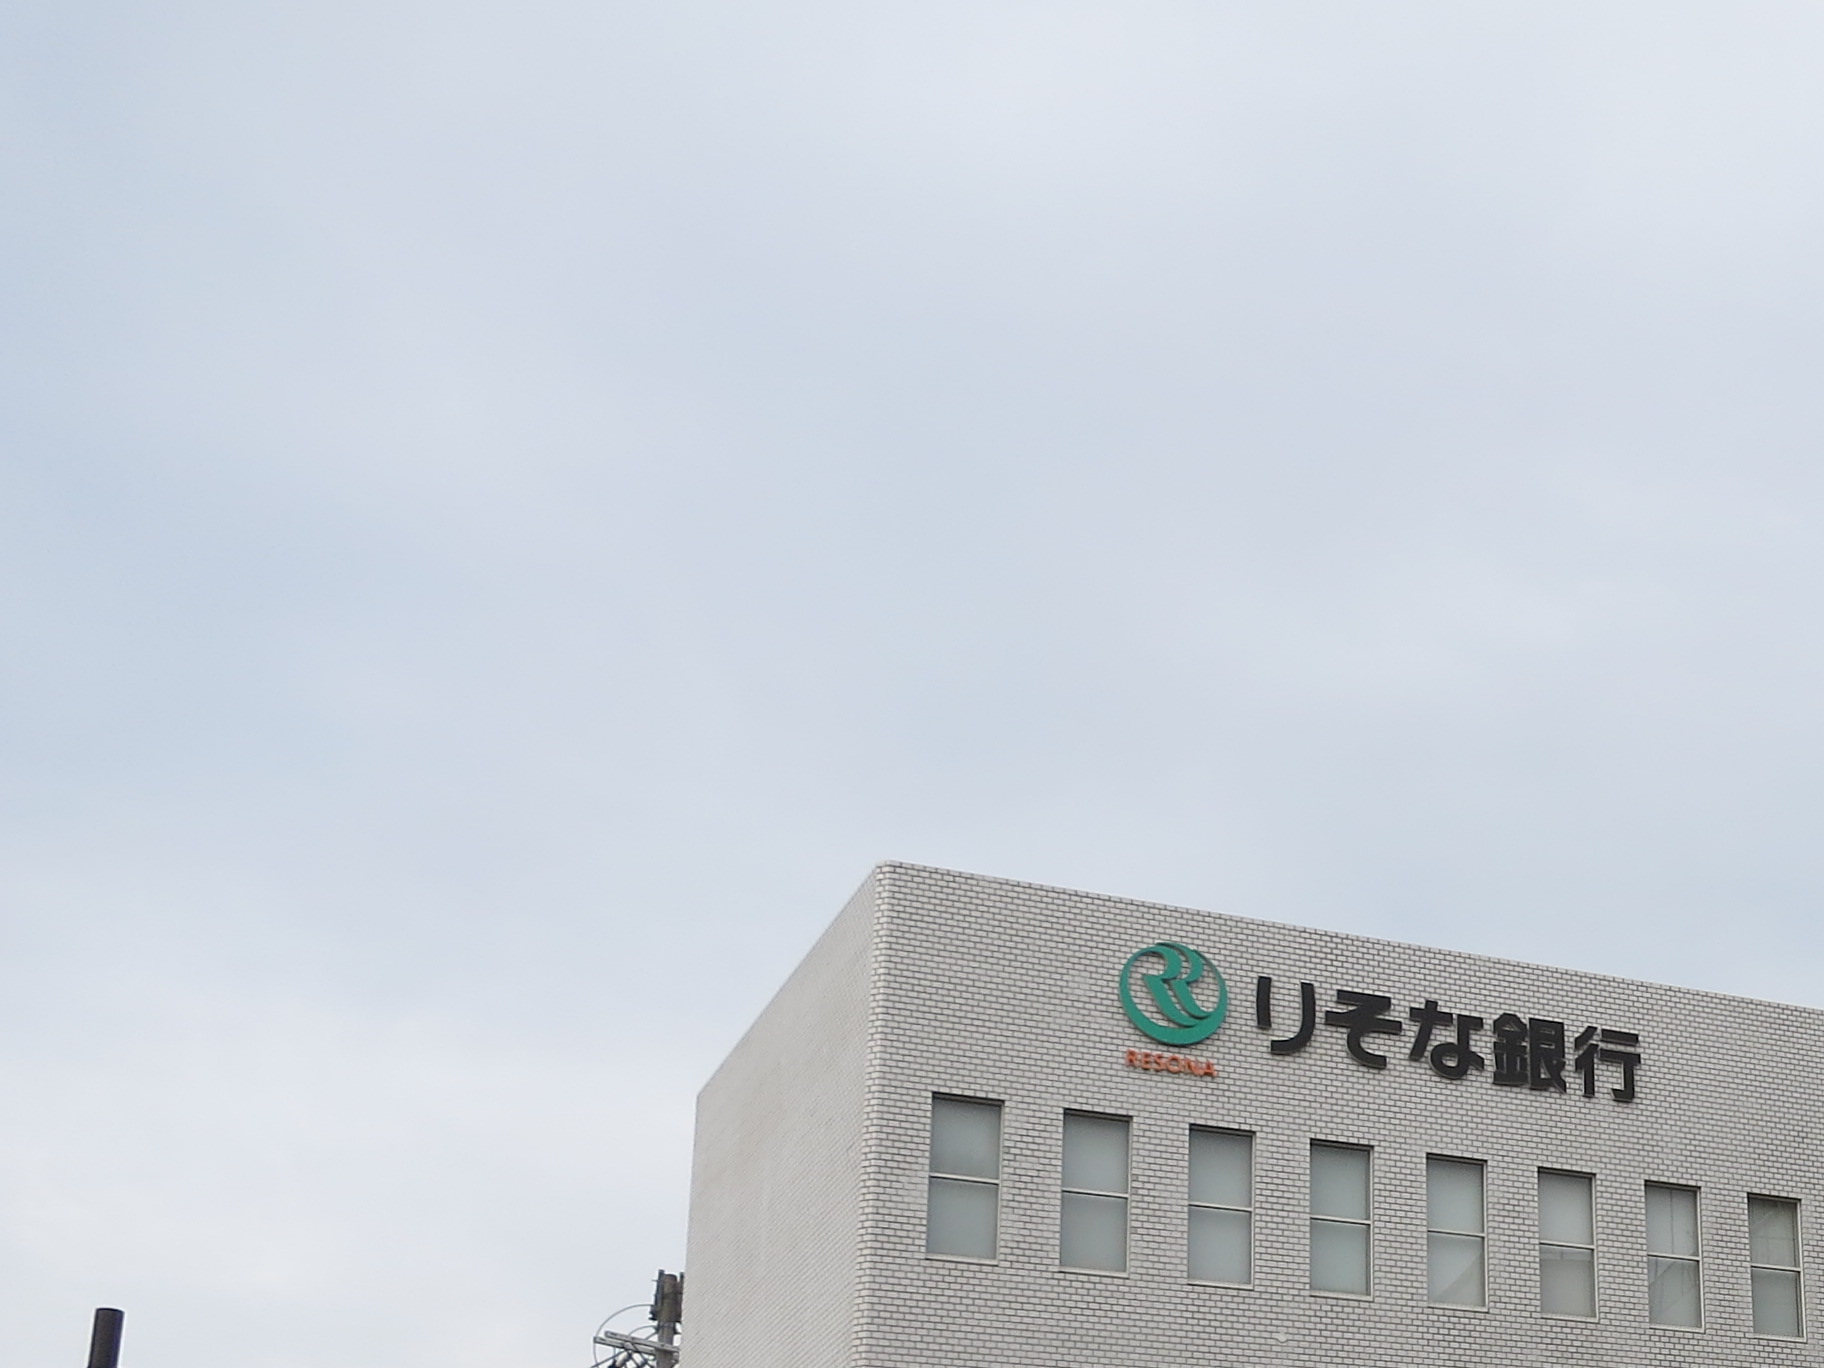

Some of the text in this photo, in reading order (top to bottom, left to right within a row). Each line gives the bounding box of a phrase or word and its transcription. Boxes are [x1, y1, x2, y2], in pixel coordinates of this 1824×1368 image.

[1125, 1049, 1218, 1078] RESONA
[1255, 974, 1642, 1102] りそな銀行
